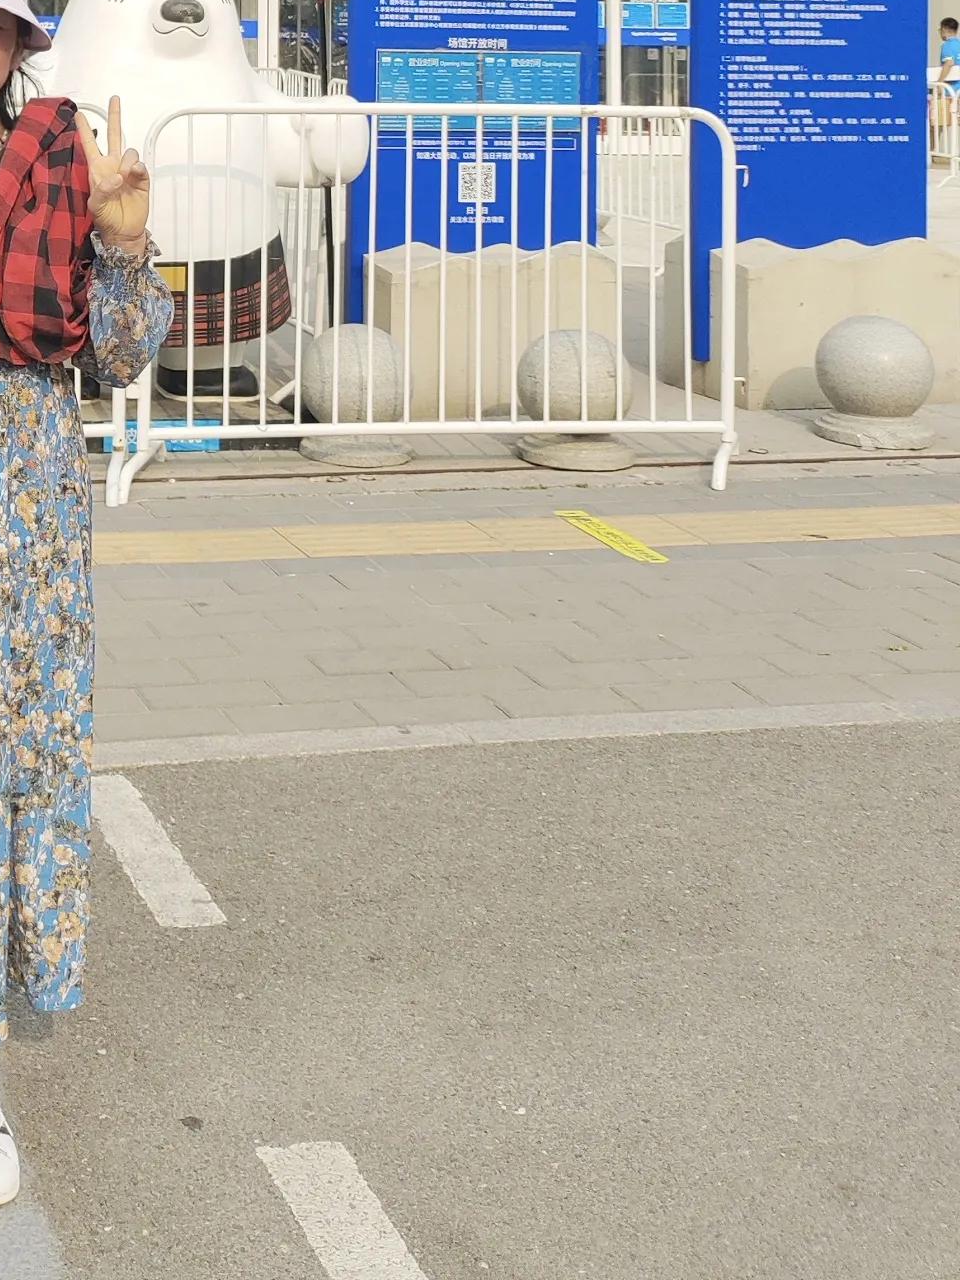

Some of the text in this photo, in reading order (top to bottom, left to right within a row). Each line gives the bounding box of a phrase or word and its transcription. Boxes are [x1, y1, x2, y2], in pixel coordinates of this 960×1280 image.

[448, 37, 508, 49] 场馆开放时间
